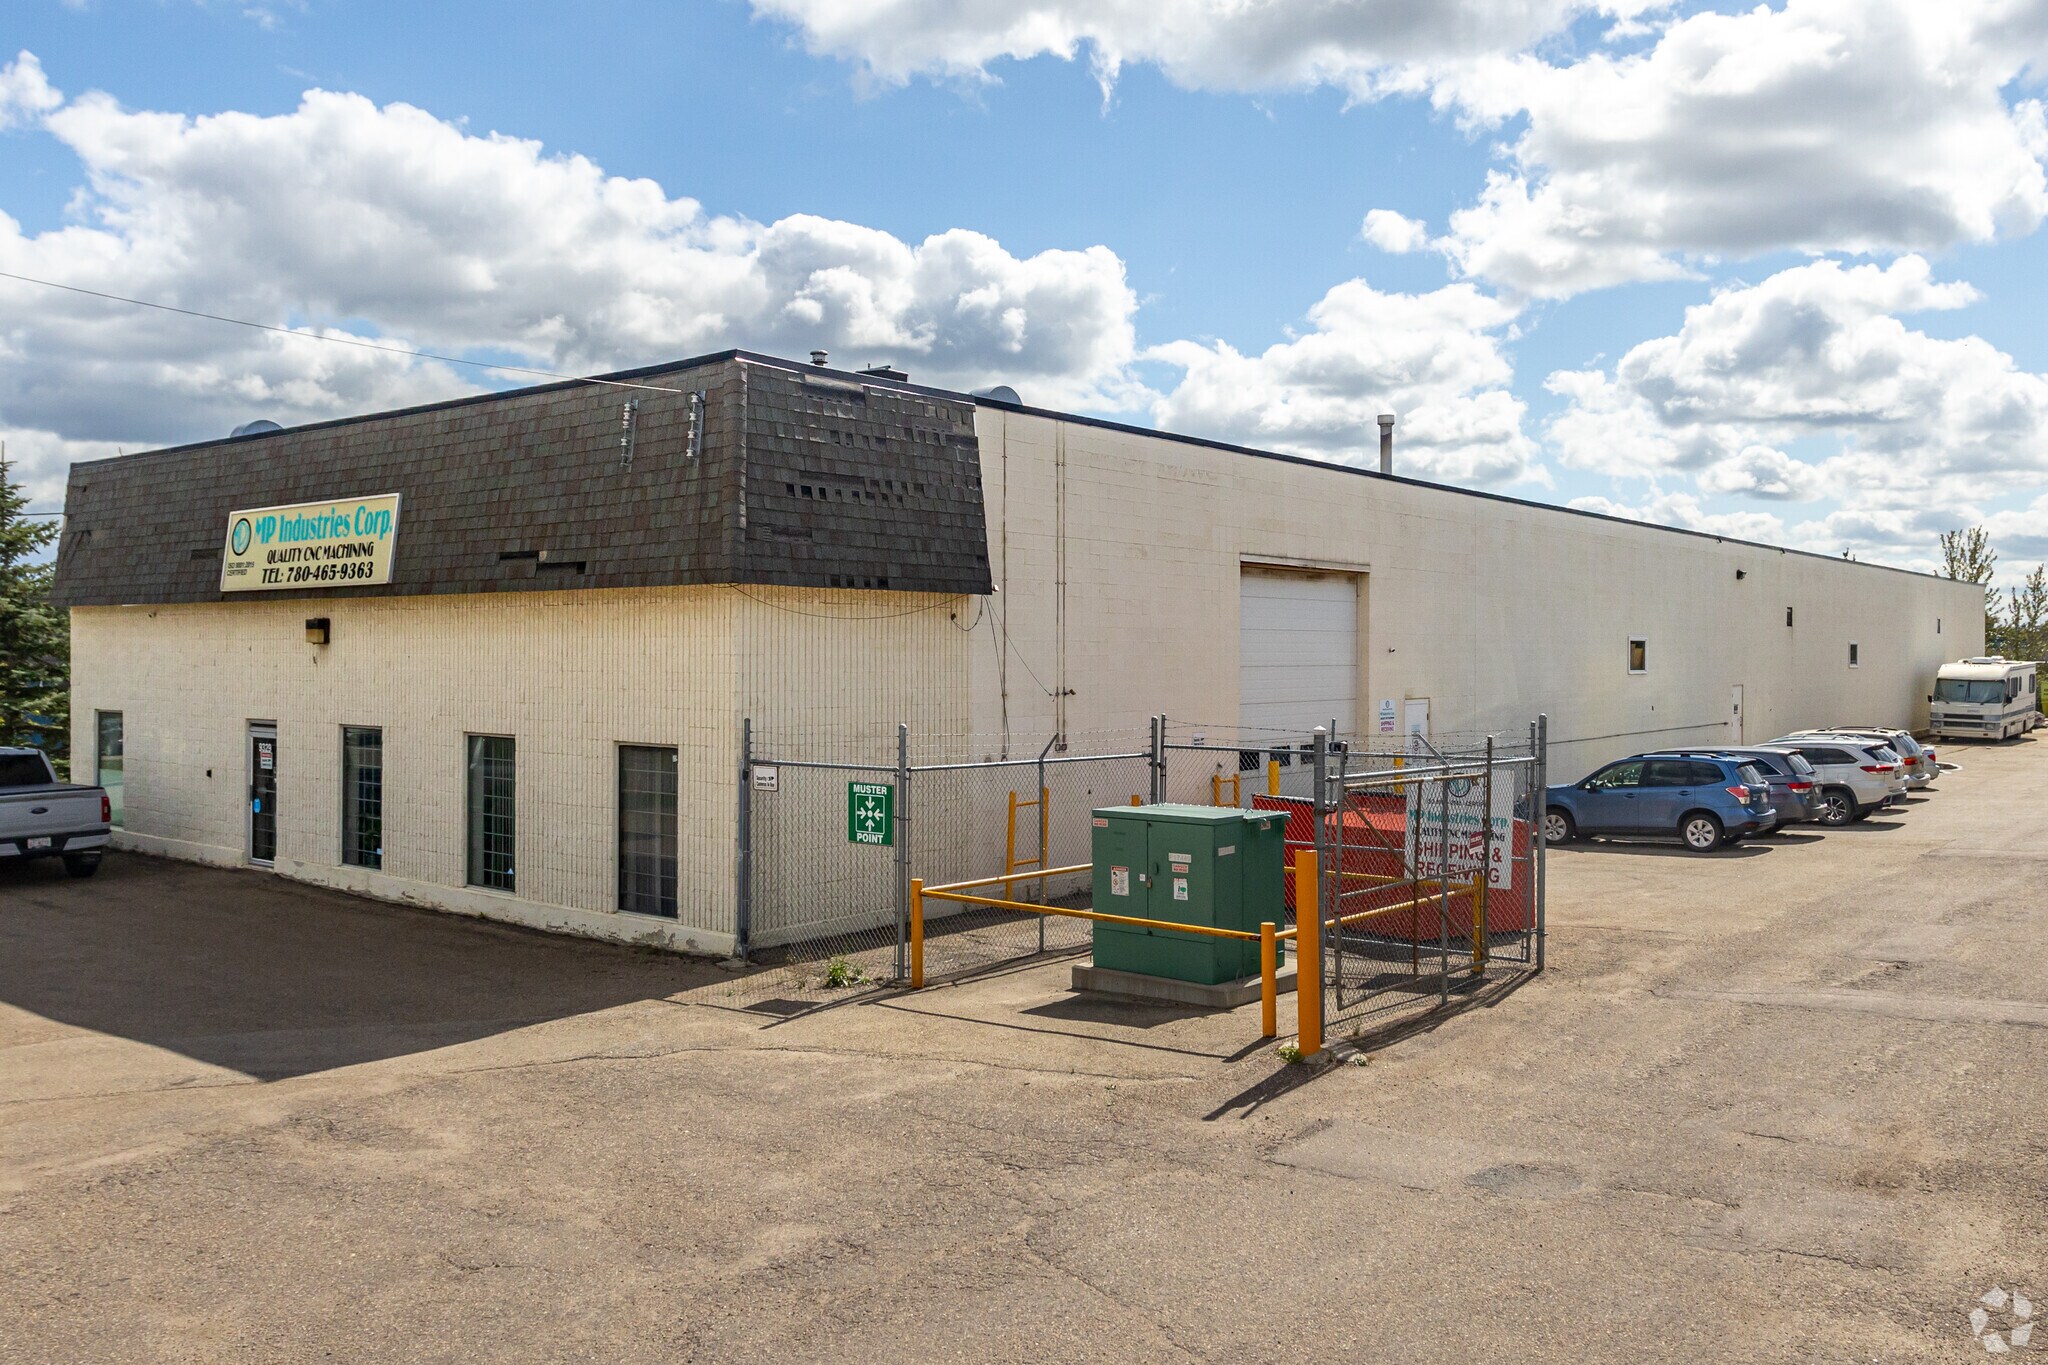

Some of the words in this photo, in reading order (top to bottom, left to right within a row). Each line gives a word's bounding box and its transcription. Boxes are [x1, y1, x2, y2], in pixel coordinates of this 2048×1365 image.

[254, 515, 277, 545] MP
[278, 507, 350, 542] Industries
[354, 505, 393, 541] Corp.
[267, 547, 302, 564] QUALITY
[303, 545, 322, 562] CNC
[322, 541, 375, 560] MACHINING
[261, 567, 284, 584] TEL:
[286, 561, 374, 583] 780-465-9363
[853, 784, 887, 795] MUSTER
[856, 833, 883, 844] POINT
[1491, 847, 1502, 863] &
